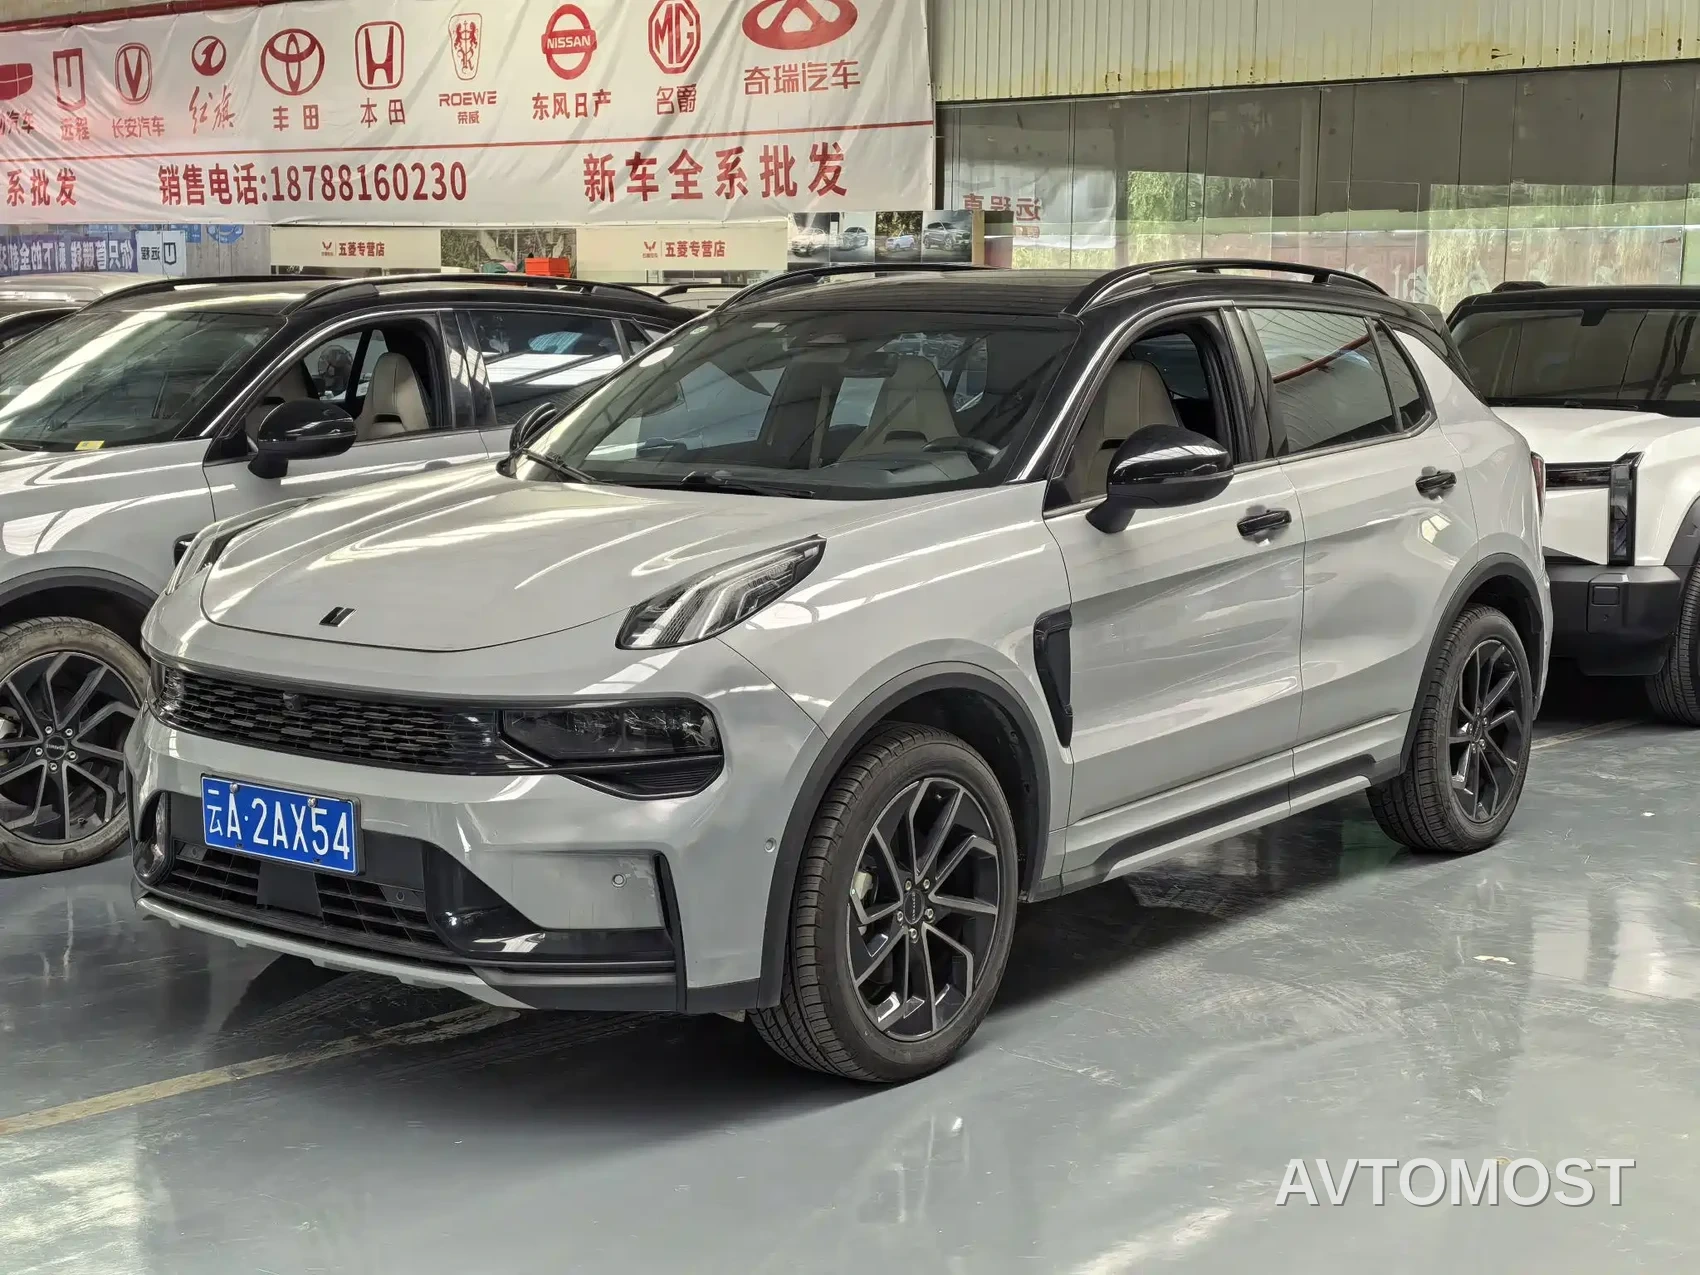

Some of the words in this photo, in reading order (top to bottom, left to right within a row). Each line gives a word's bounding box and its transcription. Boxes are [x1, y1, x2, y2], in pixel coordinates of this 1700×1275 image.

[546, 35, 591, 49] NISSAN
[653, 3, 694, 65] MG
[744, 60, 860, 95] 奇瑞汽车
[189, 85, 235, 134] 红旗
[360, 98, 405, 128] 本田
[439, 91, 497, 107] ROEWE
[532, 89, 612, 120] 东风日产
[656, 83, 697, 115] 名爵
[60, 117, 90, 141] 远程
[112, 116, 165, 138] 长安汽车
[273, 105, 319, 131] 丰田
[457, 110, 480, 124] 荣威
[7, 167, 76, 206] 系批发
[158, 161, 467, 206] 销售电话:18788160230
[583, 141, 848, 202] 新车全系批发
[339, 242, 385, 257] 五菱专营店
[665, 240, 726, 257] 五菱专营店
